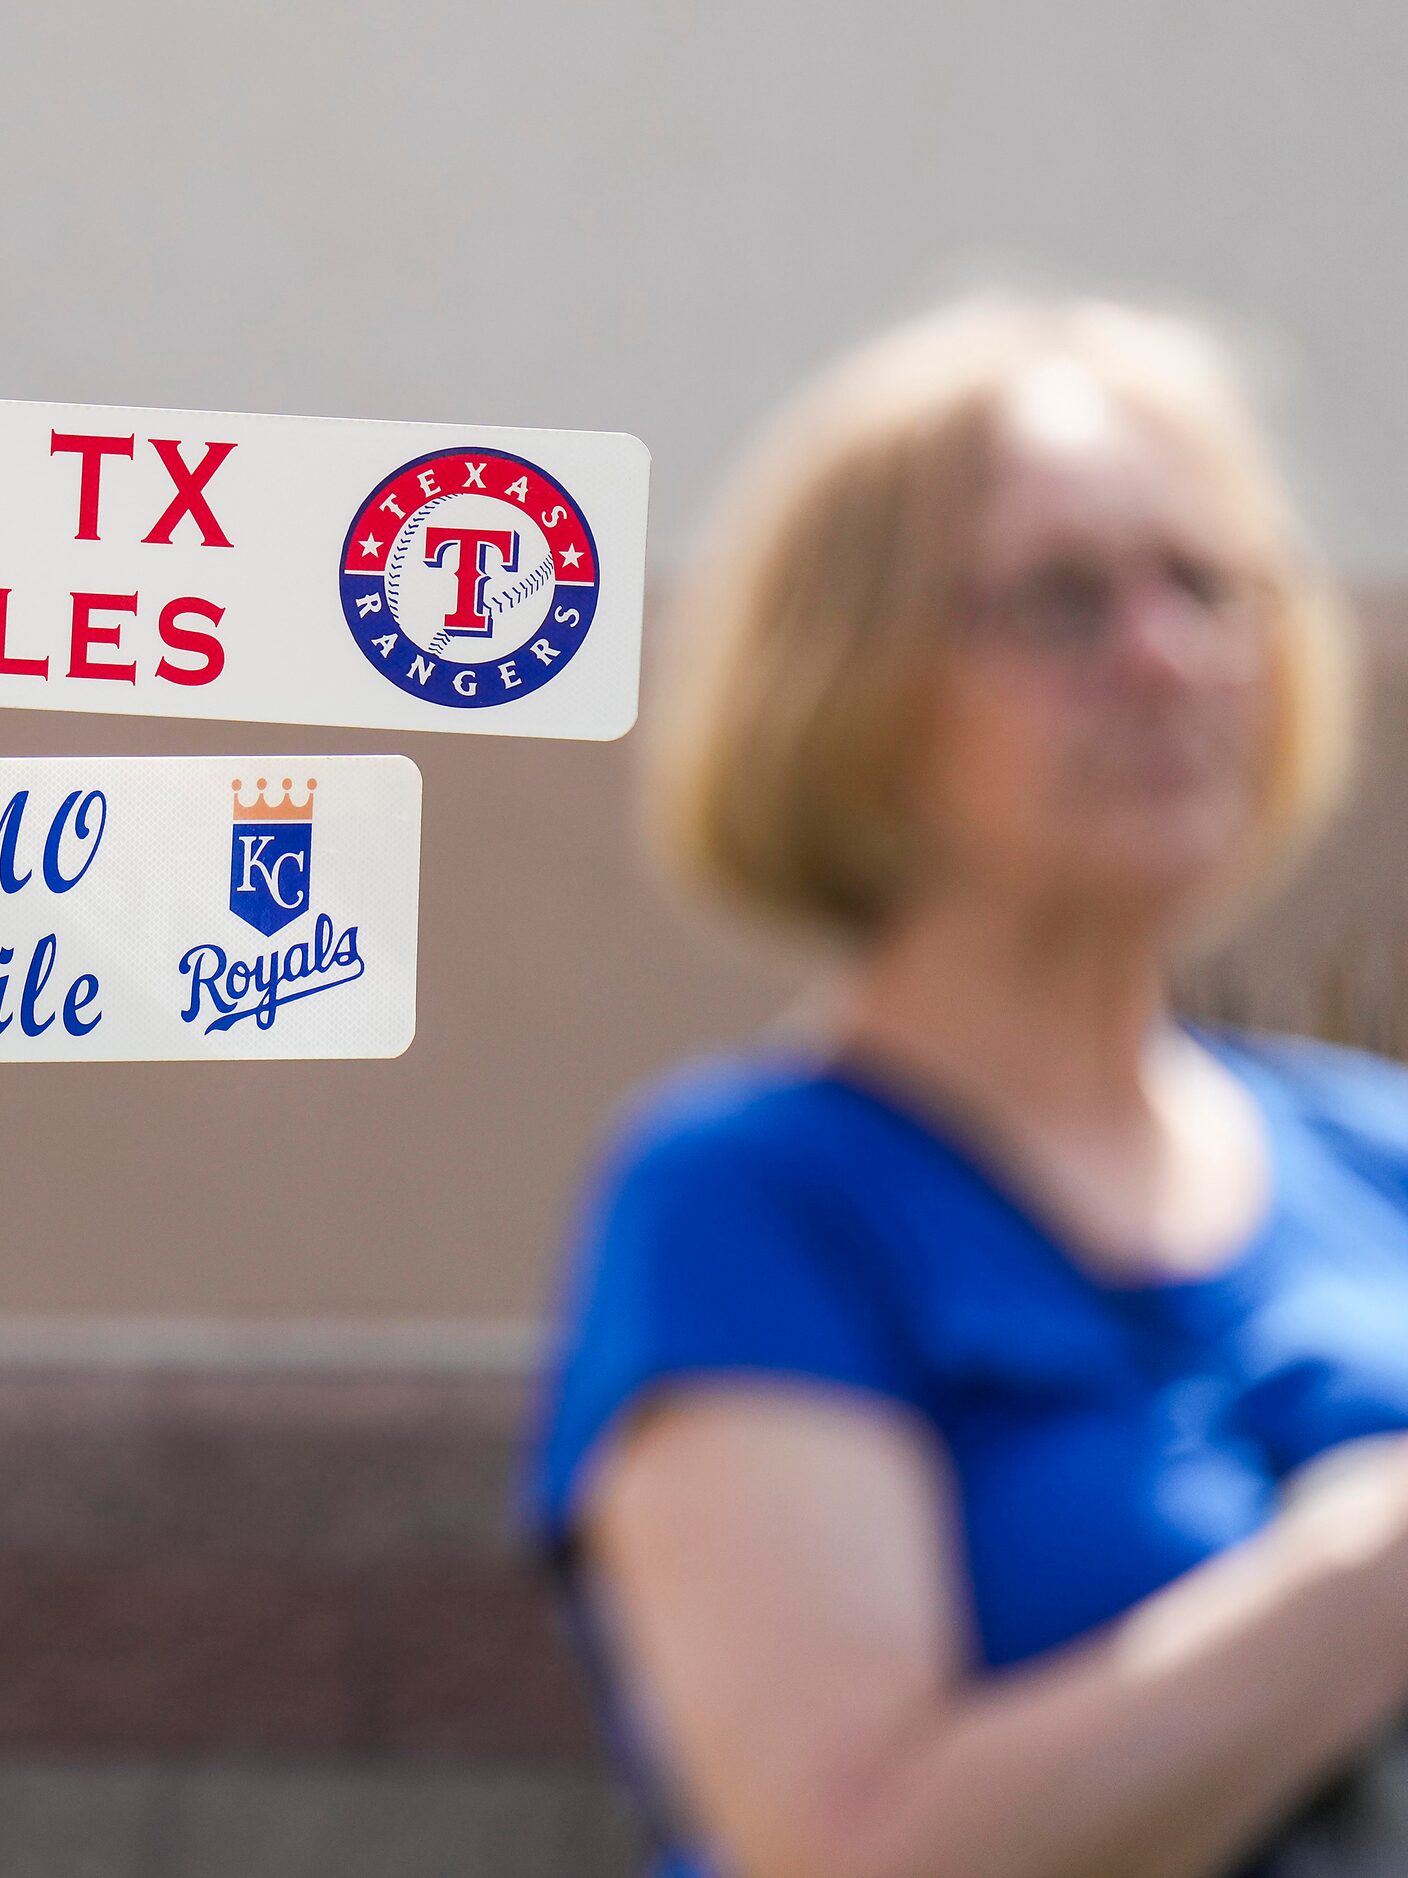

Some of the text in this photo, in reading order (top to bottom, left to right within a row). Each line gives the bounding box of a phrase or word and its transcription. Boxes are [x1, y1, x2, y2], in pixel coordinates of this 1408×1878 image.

[49, 428, 238, 549] TX
[378, 461, 568, 528] TEXAS
[423, 525, 520, 639] T
[354, 591, 581, 697] RANGERS
[236, 835, 305, 910] KC
[178, 912, 366, 1037] Royals
